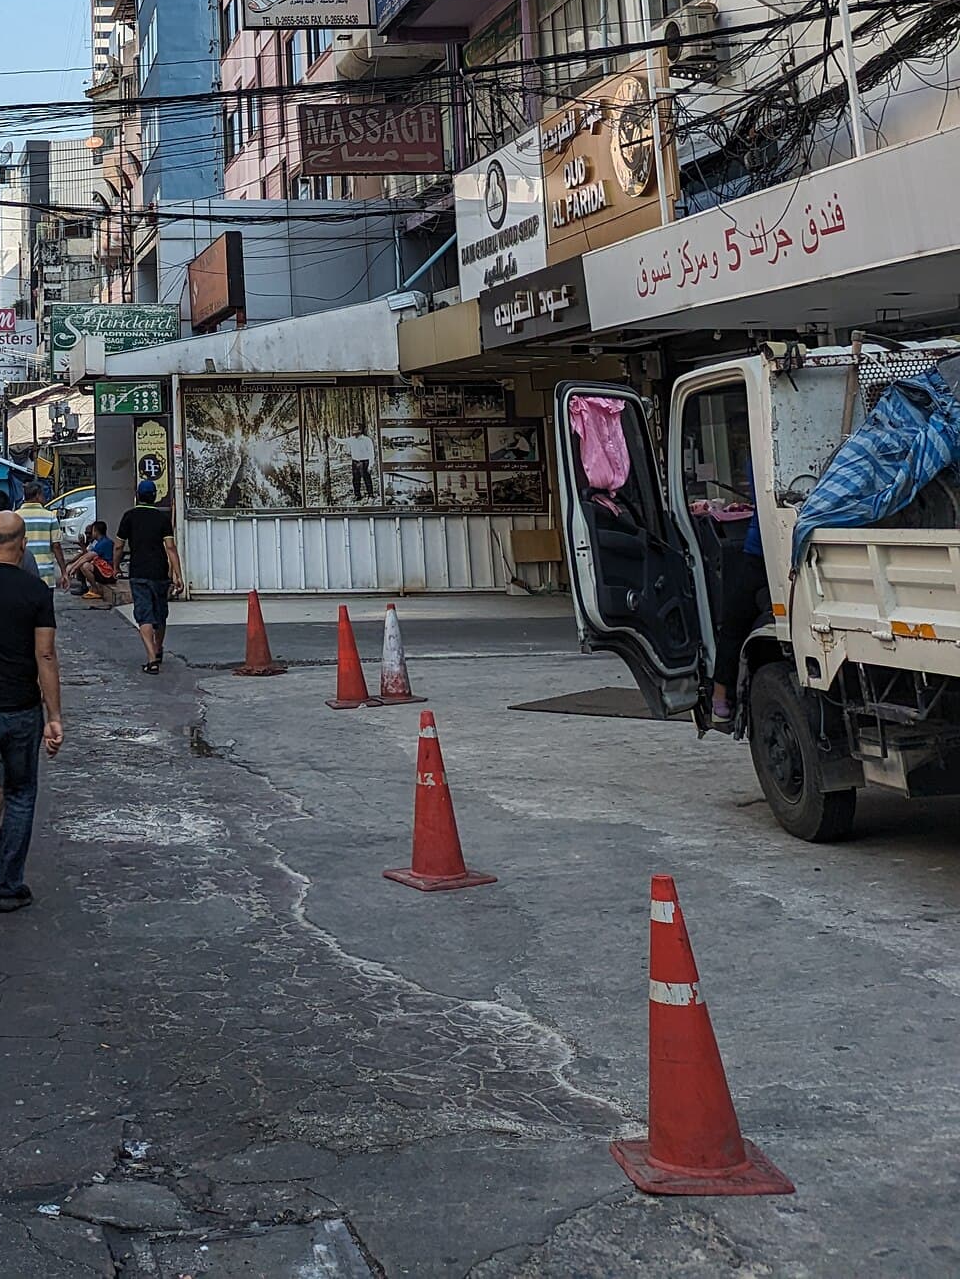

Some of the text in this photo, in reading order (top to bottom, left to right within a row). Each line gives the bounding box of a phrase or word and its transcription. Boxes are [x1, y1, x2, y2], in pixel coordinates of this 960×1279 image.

[305, 107, 437, 144] MASSAGE
[562, 156, 587, 190] OUD
[551, 180, 607, 229] AL FARIDA
[801, 193, 846, 254] فندق
[724, 228, 741, 271] 5
[636, 250, 672, 297] تسوق
